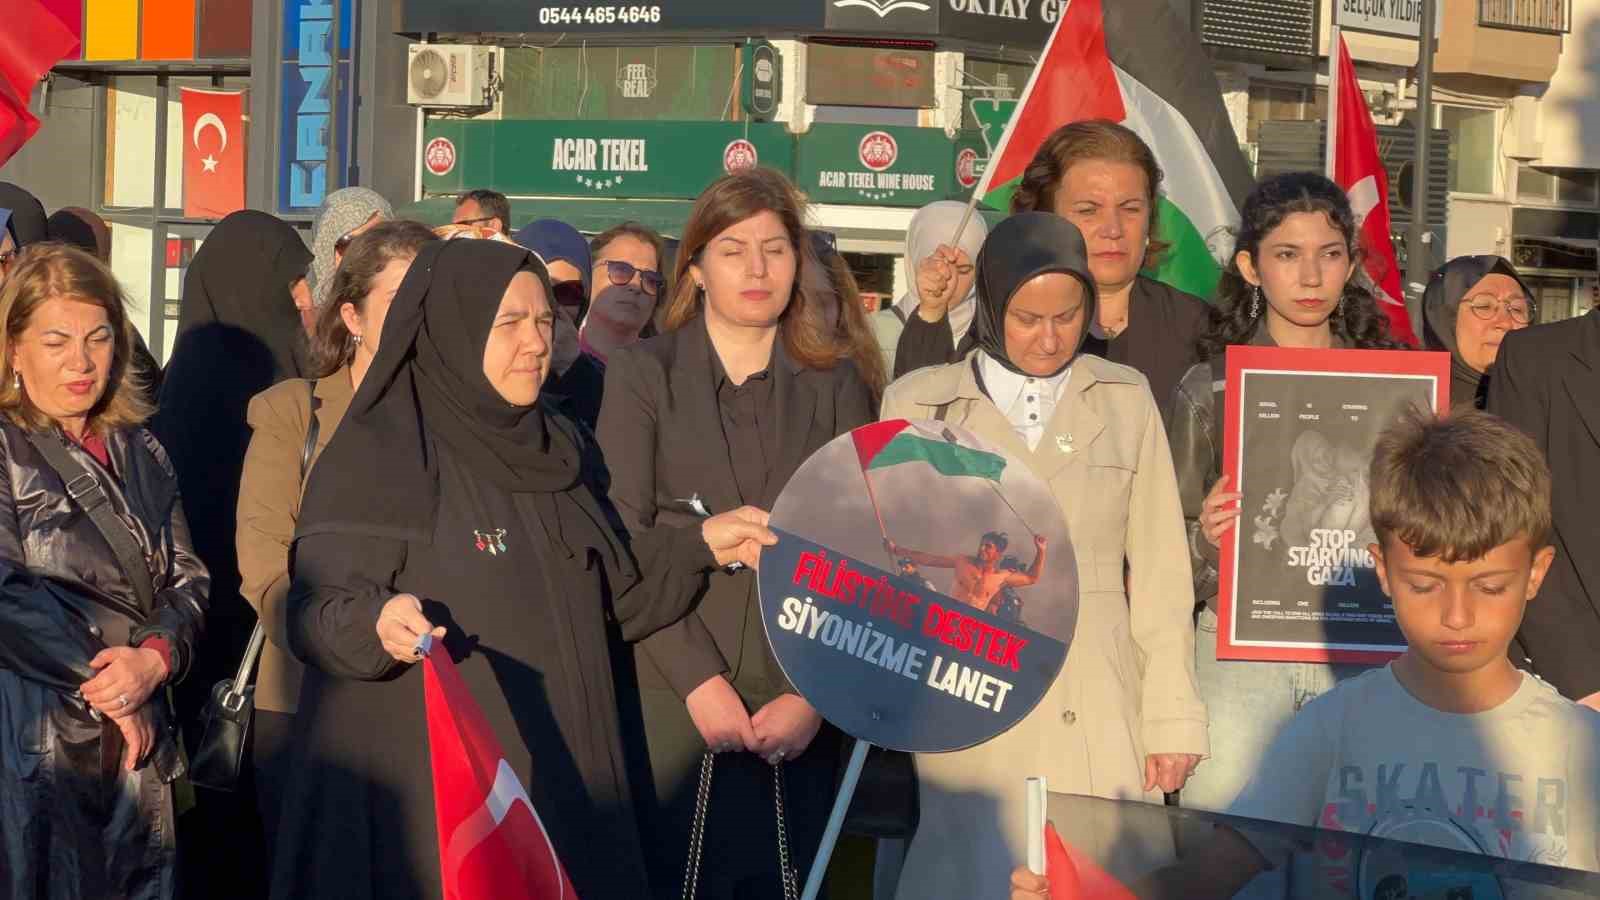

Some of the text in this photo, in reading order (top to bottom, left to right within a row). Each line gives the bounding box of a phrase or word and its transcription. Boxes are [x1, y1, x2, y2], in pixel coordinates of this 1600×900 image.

[539, 6, 661, 24] 0544 465 4646
[626, 63, 648, 80] FEEL
[623, 80, 649, 98] REAL
[552, 138, 649, 171] ACAR TEKEL
[819, 170, 935, 191] ACAR TEKEL WINE HOUSE
[1310, 528, 1357, 550] STOP
[1287, 545, 1376, 568] STARVING
[1307, 566, 1356, 587] GAZA
[792, 548, 1030, 673] FİLİSTİNE DESTEK
[777, 596, 1014, 713] SİYONİZME LANET
[1338, 761, 1569, 837] SKATER
